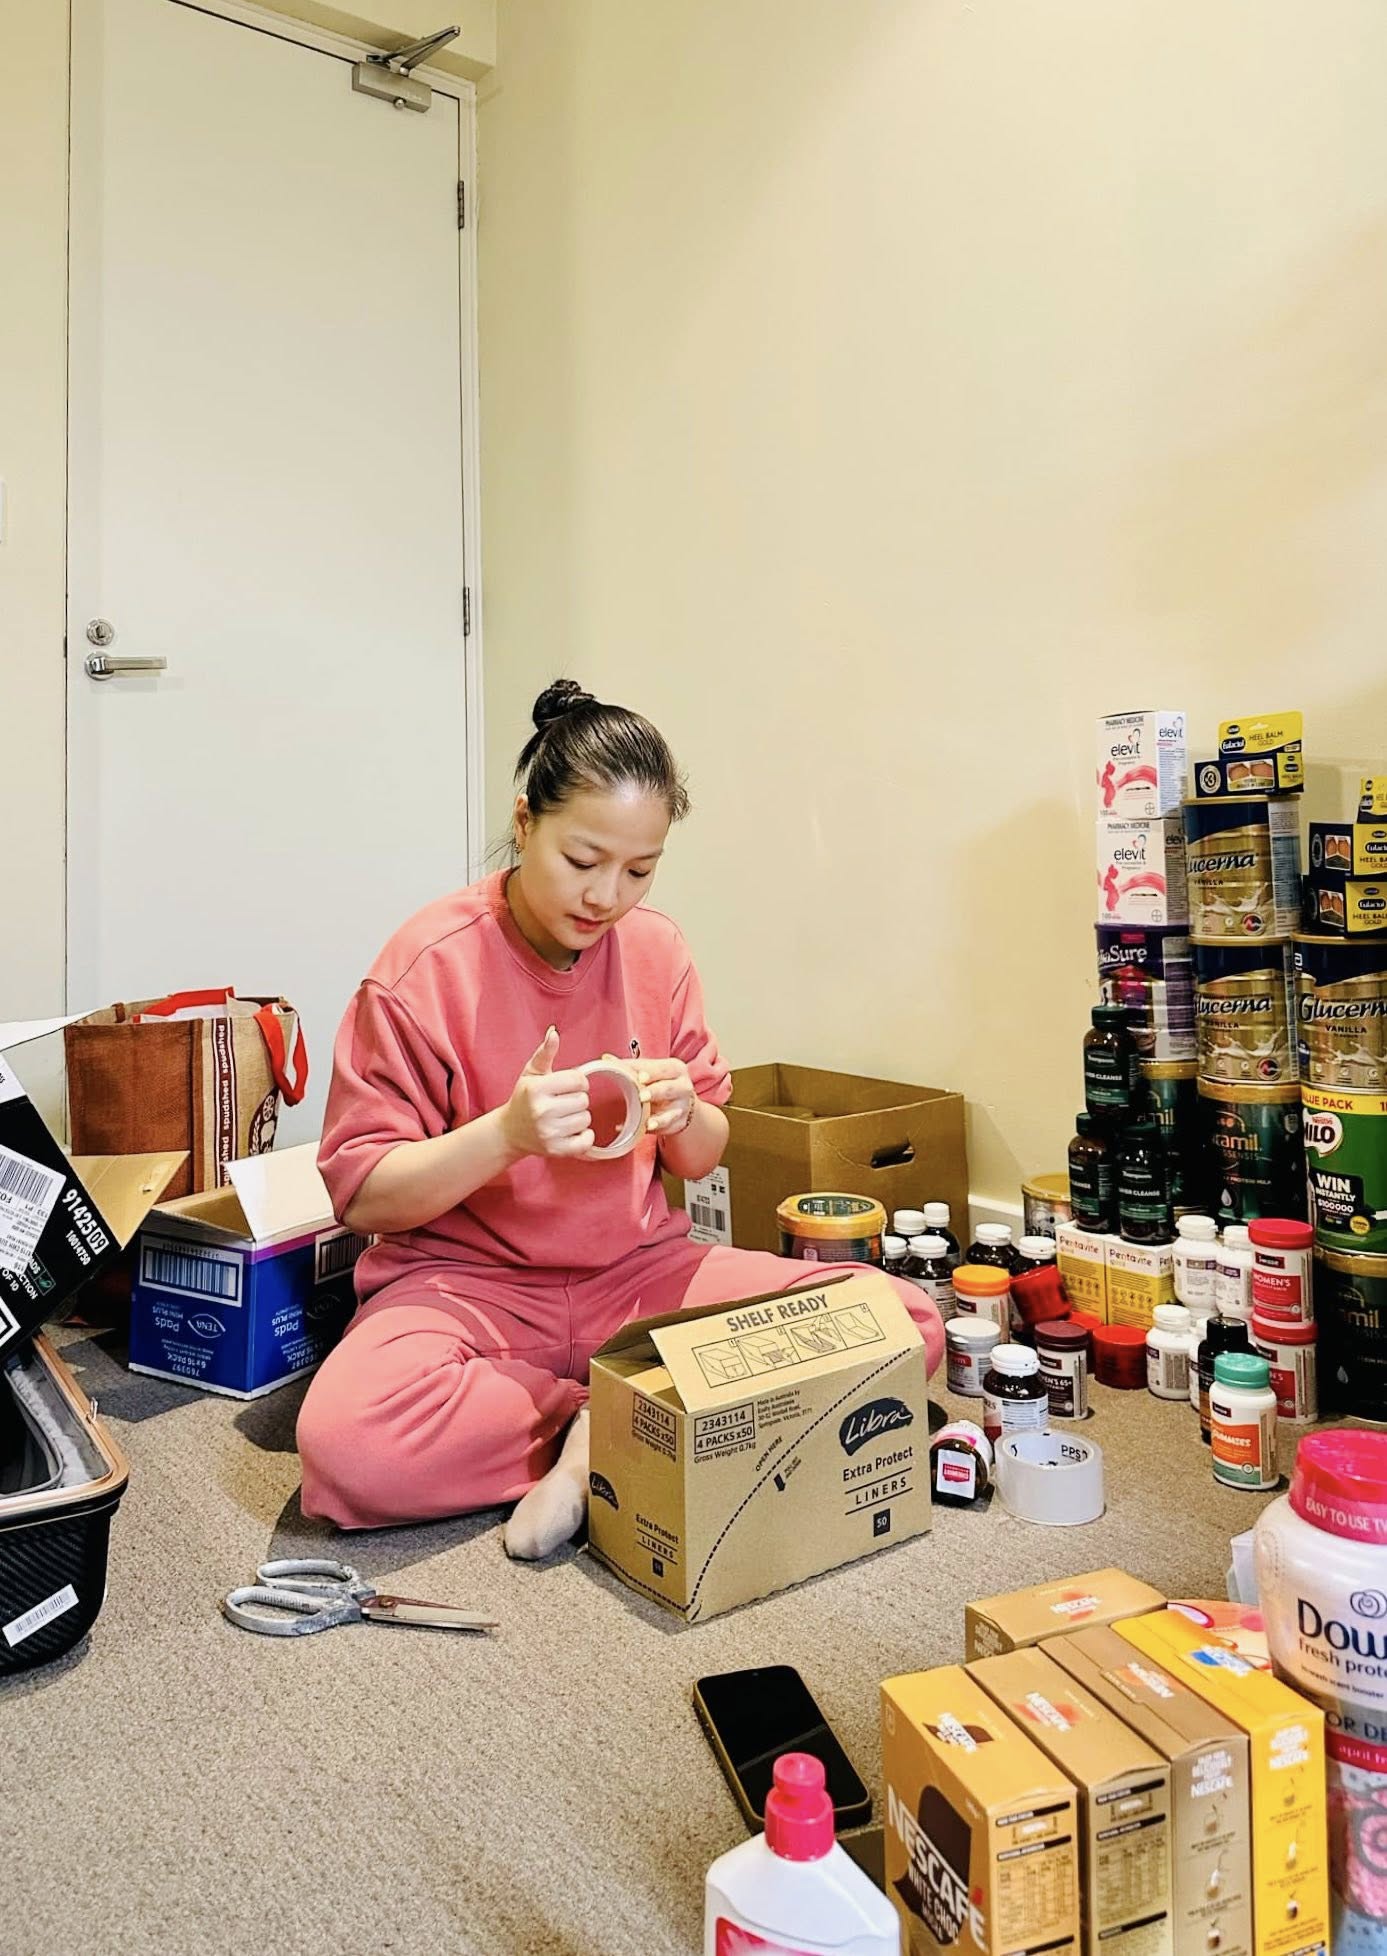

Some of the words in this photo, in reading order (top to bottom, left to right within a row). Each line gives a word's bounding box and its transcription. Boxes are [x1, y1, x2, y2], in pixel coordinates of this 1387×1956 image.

[1159, 728, 1183, 738] elevit
[1265, 731, 1283, 739] BALM
[1111, 742, 1141, 757] elevit
[1114, 848, 1146, 861] elevit
[1194, 996, 1271, 1018] lucerna
[1301, 993, 1387, 1023] Glucern
[1325, 1024, 1367, 1034] VANILLA
[218, 1024, 229, 1074] spudshed
[1096, 1073, 1122, 1081] CLEANSE
[222, 1079, 231, 1131] spudshed
[1322, 1098, 1353, 1111] PACK
[1316, 1172, 1351, 1194] WIN
[1315, 1187, 1356, 1202] INSTANTLY
[1059, 1235, 1099, 1254] Pentavite
[1109, 1248, 1153, 1267] Pentavite
[9, 1280, 19, 1292] 10
[152, 1305, 169, 1317] PLUS
[271, 1313, 288, 1326] PLUS
[726, 1307, 775, 1332] SHELF
[778, 1293, 829, 1321] READY
[154, 1316, 180, 1333] Pads
[196, 1319, 218, 1333] TENA
[274, 1319, 299, 1337] Pads
[167, 1352, 187, 1364] PACK
[637, 1400, 670, 1426] 2343114
[702, 1411, 745, 1431] 2343114
[633, 1416, 640, 1426] 4
[639, 1419, 661, 1441] PACKS
[660, 1431, 674, 1446] x50
[845, 1409, 913, 1445] Libra
[697, 1439, 703, 1449] 4
[705, 1433, 735, 1448] PACKS
[736, 1426, 753, 1439] x50
[693, 1453, 714, 1465] Gross
[715, 1447, 738, 1461] Weight
[755, 1453, 770, 1472] OPEN
[769, 1436, 783, 1455] HERE
[843, 1463, 872, 1482] Extra
[875, 1446, 913, 1469] Protect
[855, 1476, 907, 1505] LINERS
[876, 1516, 887, 1528] 50
[1305, 1496, 1327, 1519] EASY
[1330, 1509, 1347, 1526] TO
[1350, 1514, 1371, 1532] USE
[636, 1513, 654, 1532] Extra
[654, 1523, 679, 1545] Protect
[641, 1536, 674, 1559] LINERS
[1298, 1597, 1387, 1660] Dow
